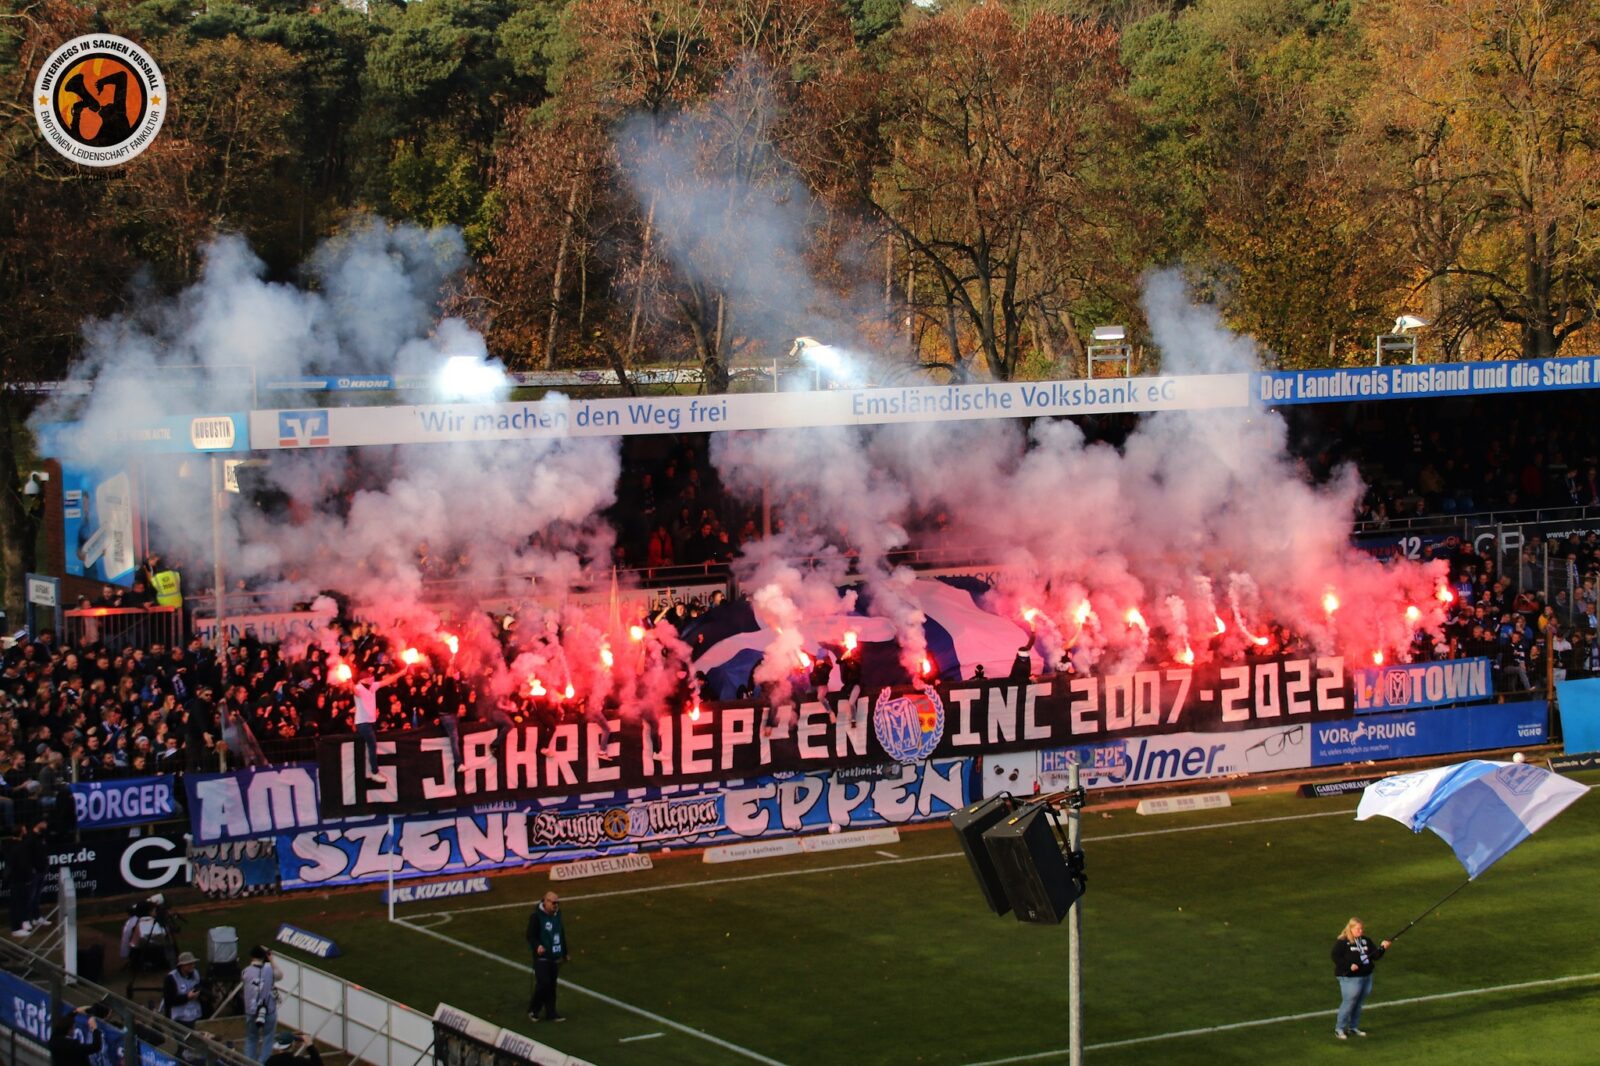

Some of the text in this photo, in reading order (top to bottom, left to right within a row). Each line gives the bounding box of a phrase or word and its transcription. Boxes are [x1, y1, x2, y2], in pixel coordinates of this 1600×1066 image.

[350, 379, 389, 388] KRONE
[853, 380, 1177, 416] Emsländische Volksbank eG
[1261, 375, 1293, 400] Der
[1297, 370, 1388, 398] Landkreis
[1392, 366, 1469, 394] Emsland
[1473, 363, 1507, 389] und
[1511, 361, 1539, 387] die
[1543, 359, 1589, 385] Stadt
[420, 400, 728, 433] Wir machen den Weg frei
[1398, 536, 1421, 560] 12
[1407, 660, 1482, 702] TOWN
[420, 719, 622, 800] JAHRE
[950, 682, 1052, 746] INC
[1109, 739, 1226, 783] olmer
[74, 783, 172, 821] BÖRGER
[197, 767, 319, 840] AM
[649, 799, 719, 831] Meppen
[724, 760, 967, 837] EPPEN
[556, 855, 651, 878] BMW HELMING
[415, 880, 465, 899] KUZKA
